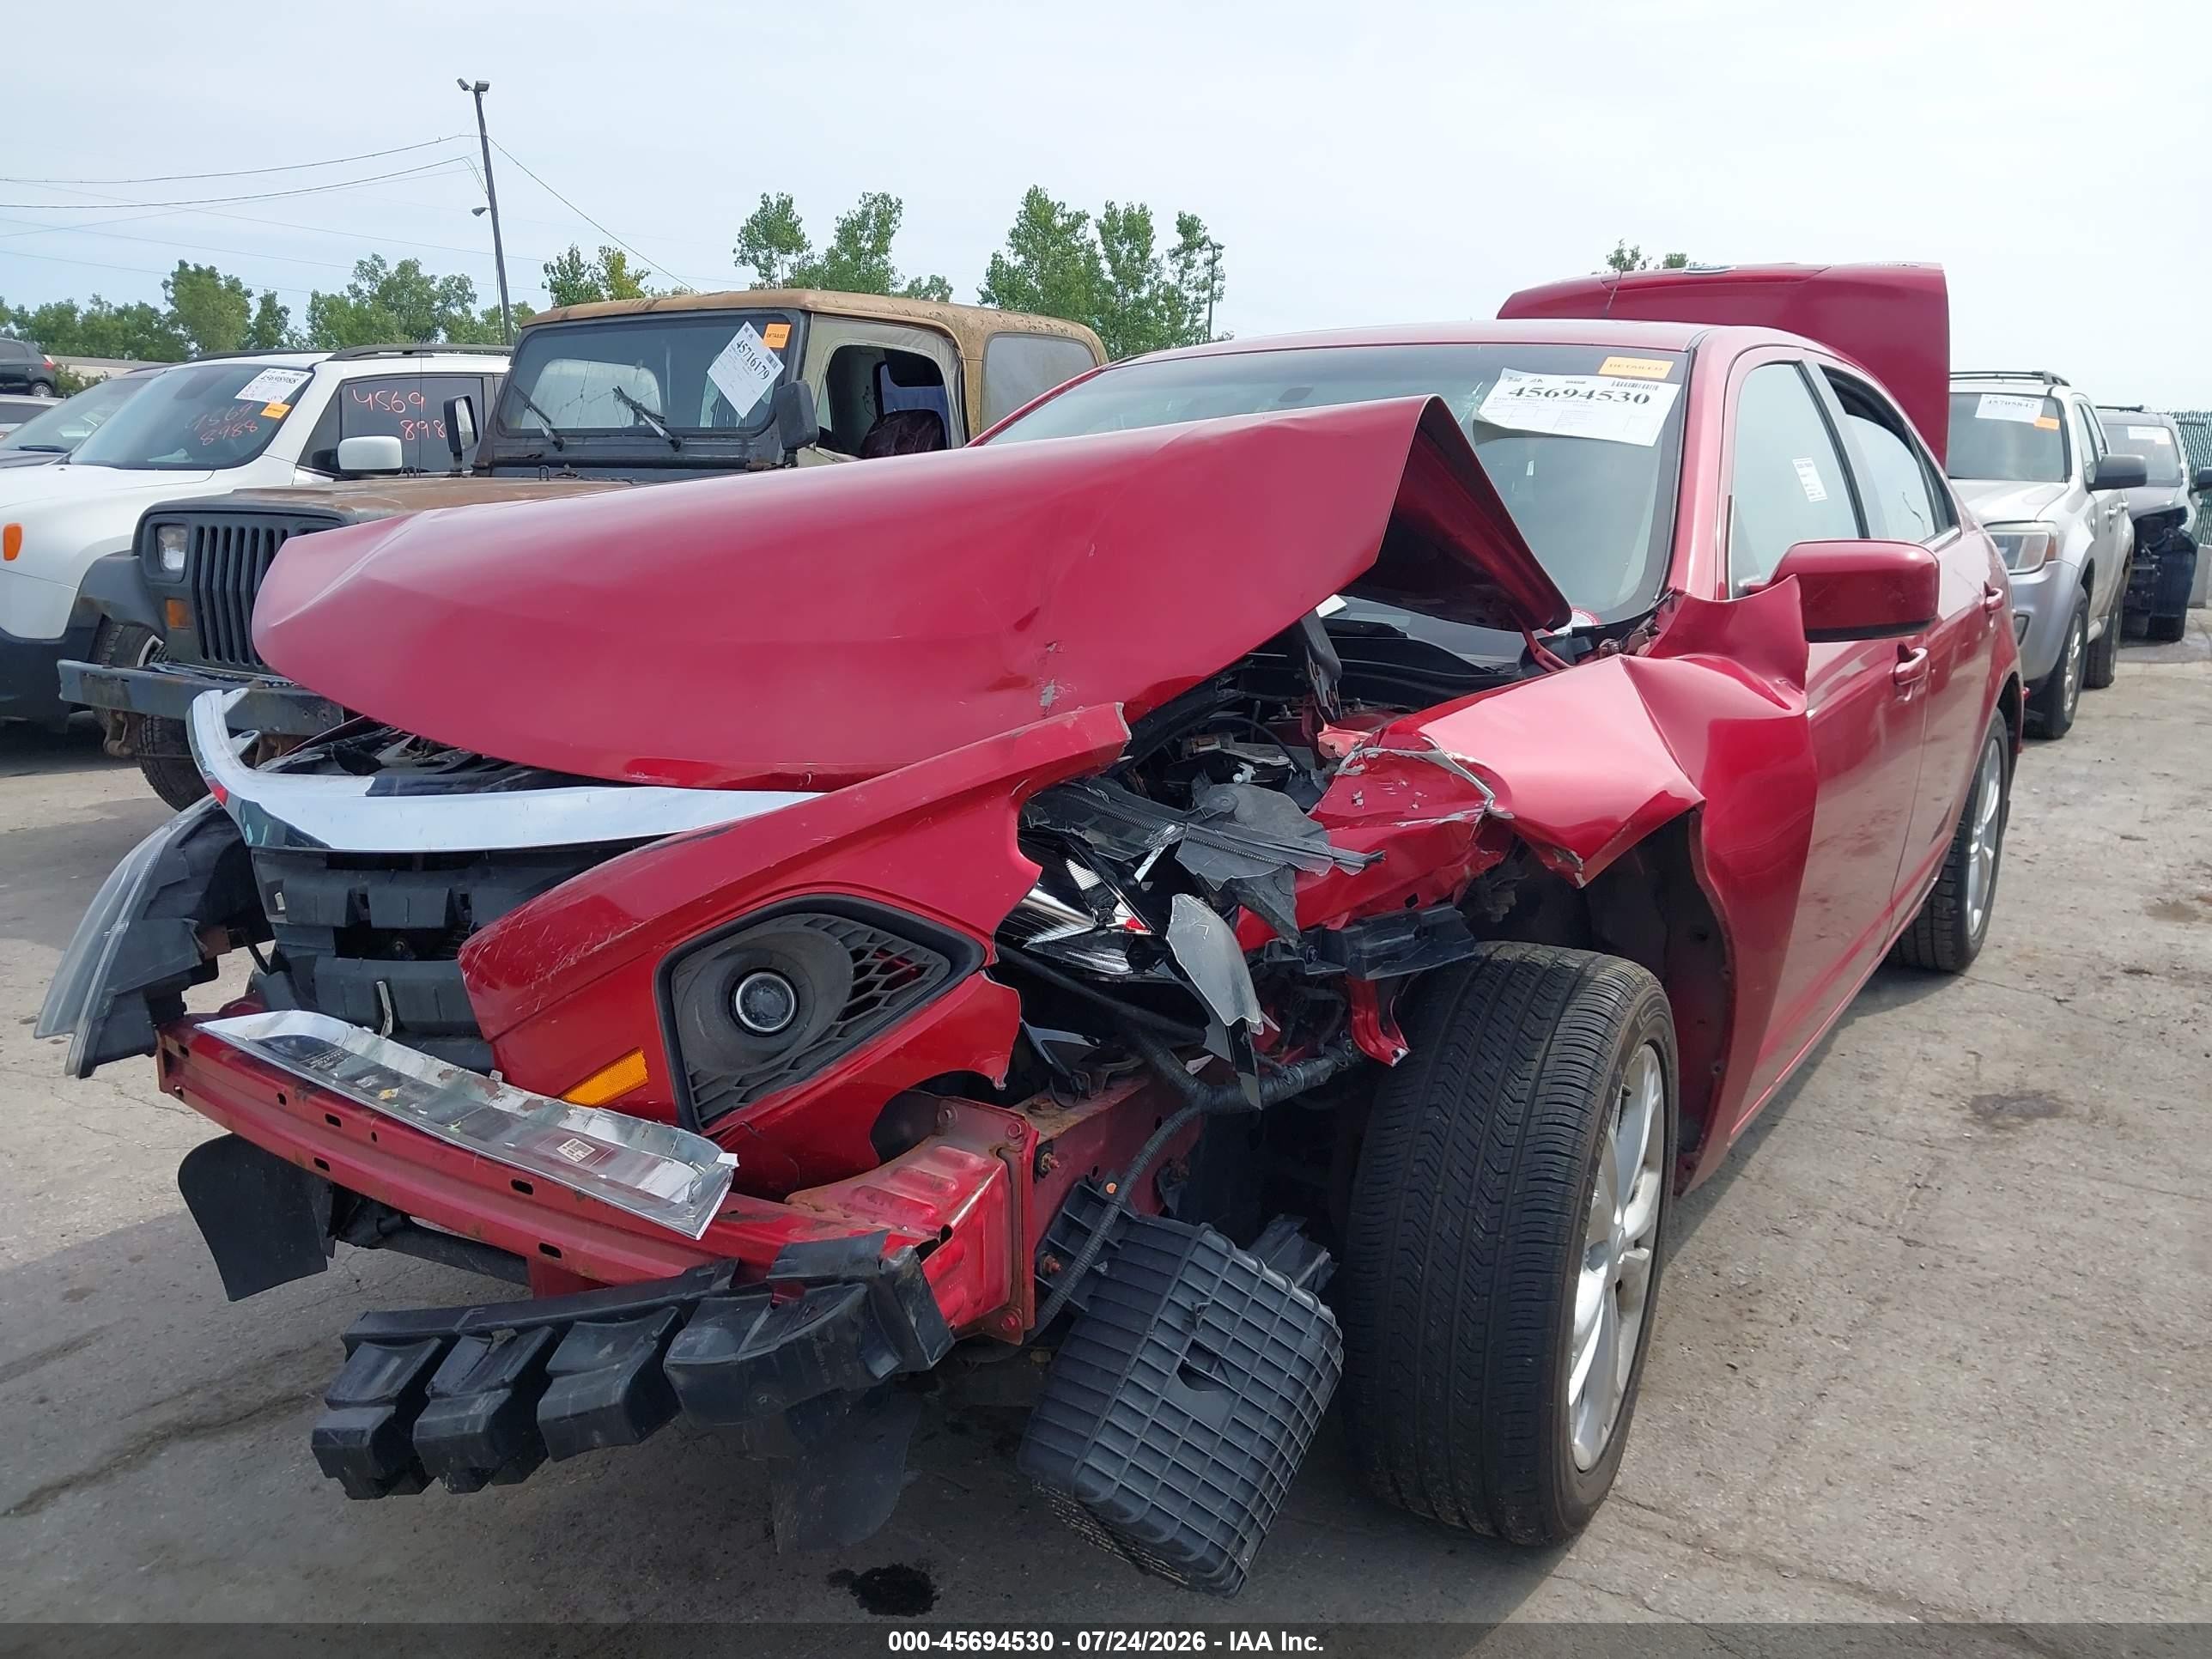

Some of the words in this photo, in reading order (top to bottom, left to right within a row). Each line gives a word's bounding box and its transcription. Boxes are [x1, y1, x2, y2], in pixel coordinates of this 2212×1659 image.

[735, 339, 770, 380] 45716179
[352, 389, 425, 413] 4569
[1507, 386, 1650, 405] 45694530
[199, 419, 258, 446] 8988
